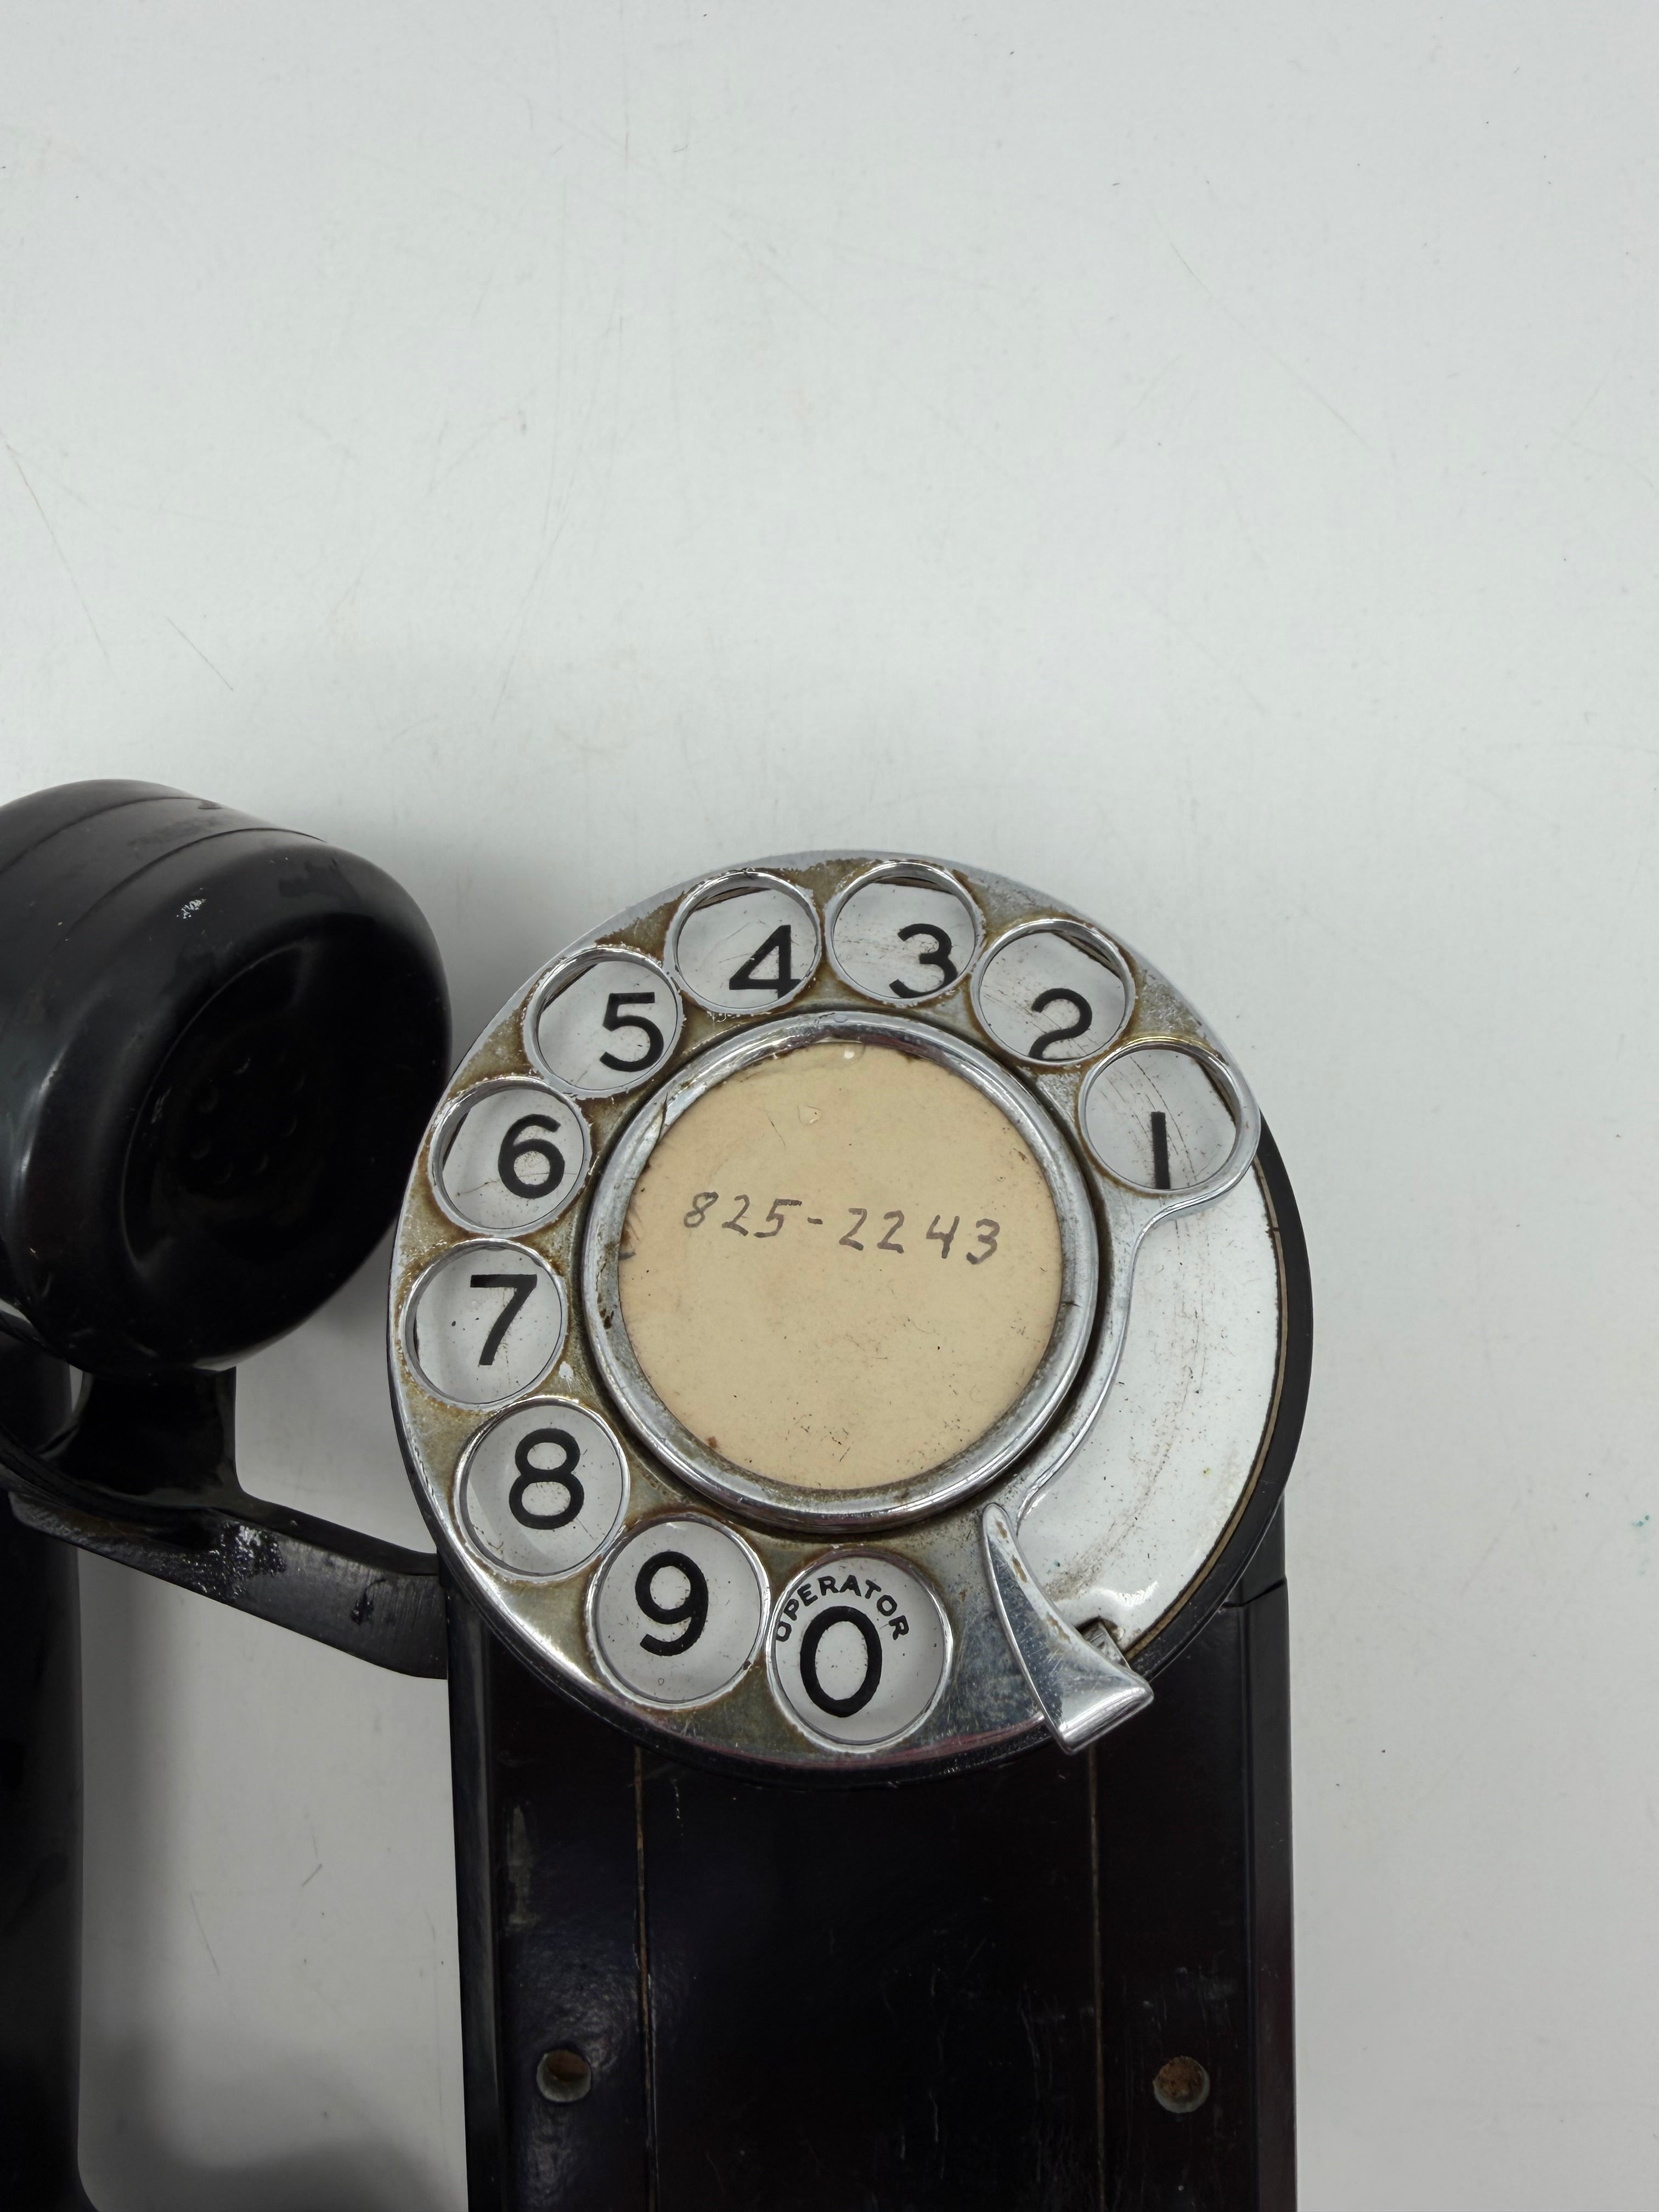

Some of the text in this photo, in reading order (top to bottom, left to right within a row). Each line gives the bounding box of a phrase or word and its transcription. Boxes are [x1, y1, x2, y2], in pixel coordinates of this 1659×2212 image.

[729, 923, 799, 998] 4
[890, 922, 957, 999] 3
[600, 991, 664, 1072] 5
[1029, 986, 1093, 1060] 2
[498, 1114, 563, 1198] 6
[1150, 1111, 1170, 1189] 1
[684, 1191, 1001, 1265] 825-2243
[469, 1274, 537, 1366] 7
[510, 1427, 585, 1530] 8
[636, 1550, 708, 1656] 9
[776, 1575, 910, 1642] OPERATOR
[799, 1606, 882, 1718] 0
